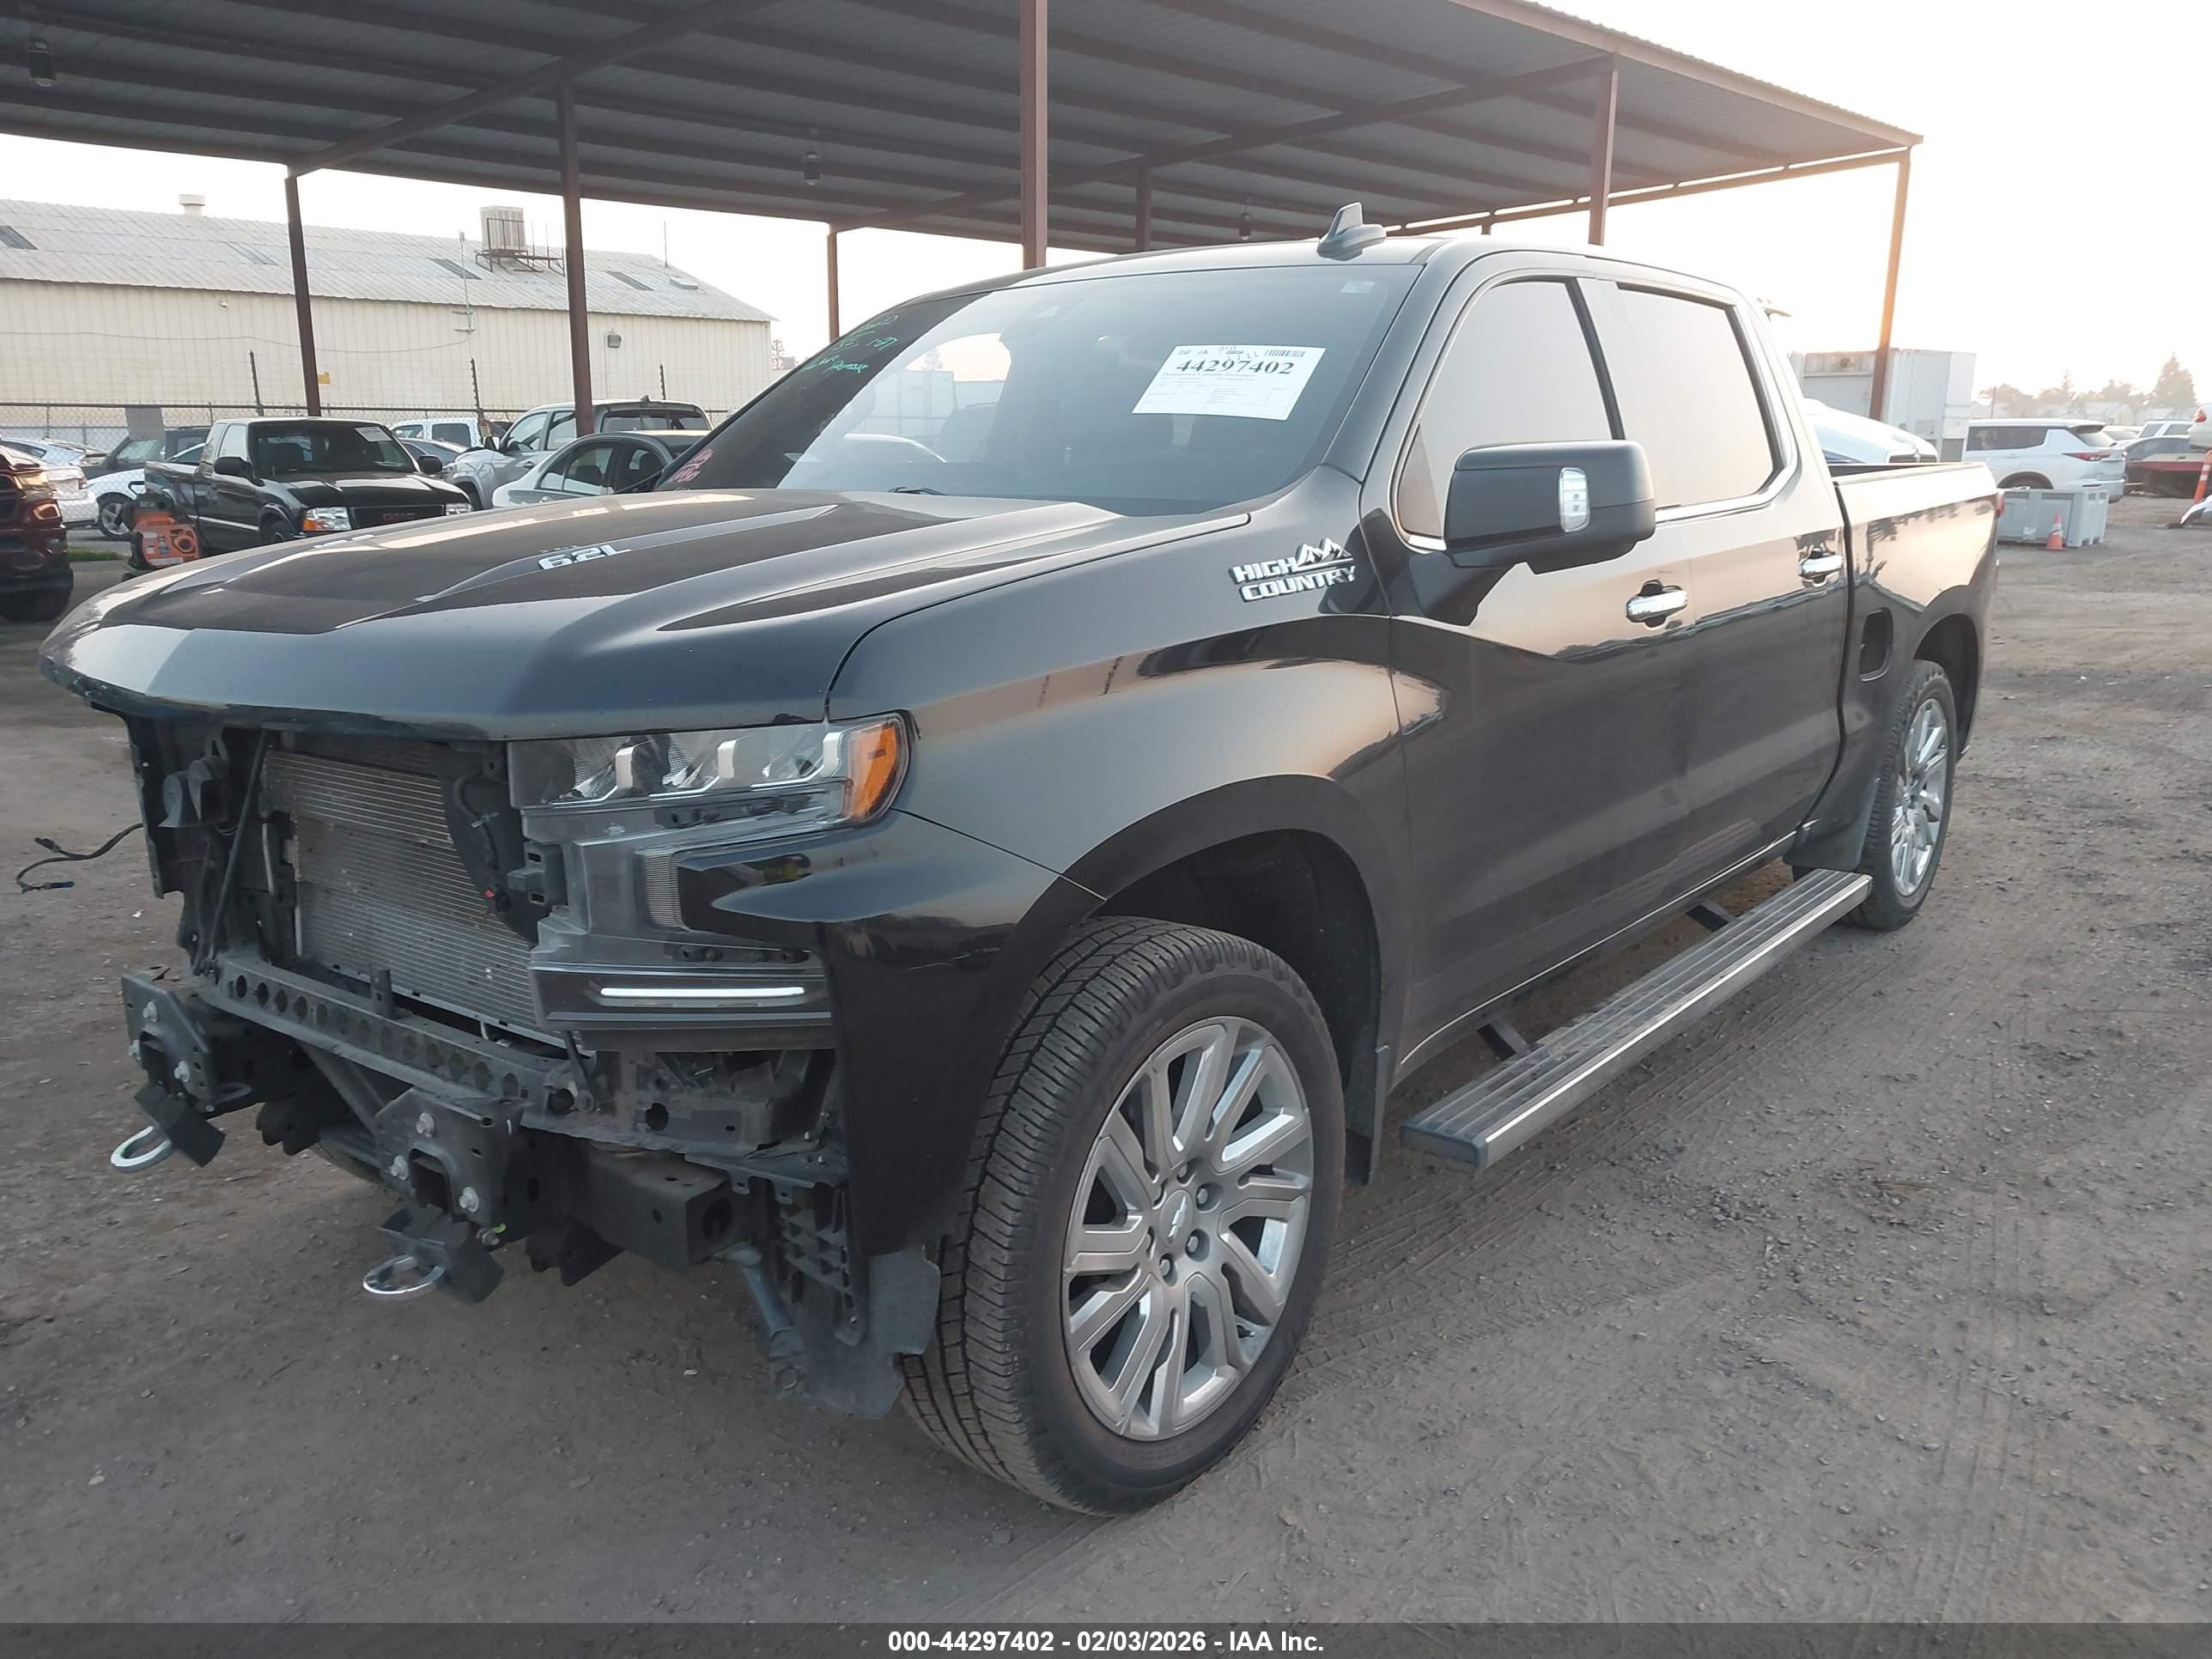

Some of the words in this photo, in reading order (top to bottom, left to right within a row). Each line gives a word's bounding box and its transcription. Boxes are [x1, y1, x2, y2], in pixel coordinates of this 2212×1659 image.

[1176, 359, 1295, 375] 44297402
[1231, 556, 1297, 583] HIGH
[1239, 565, 1357, 601] COUNTRY
